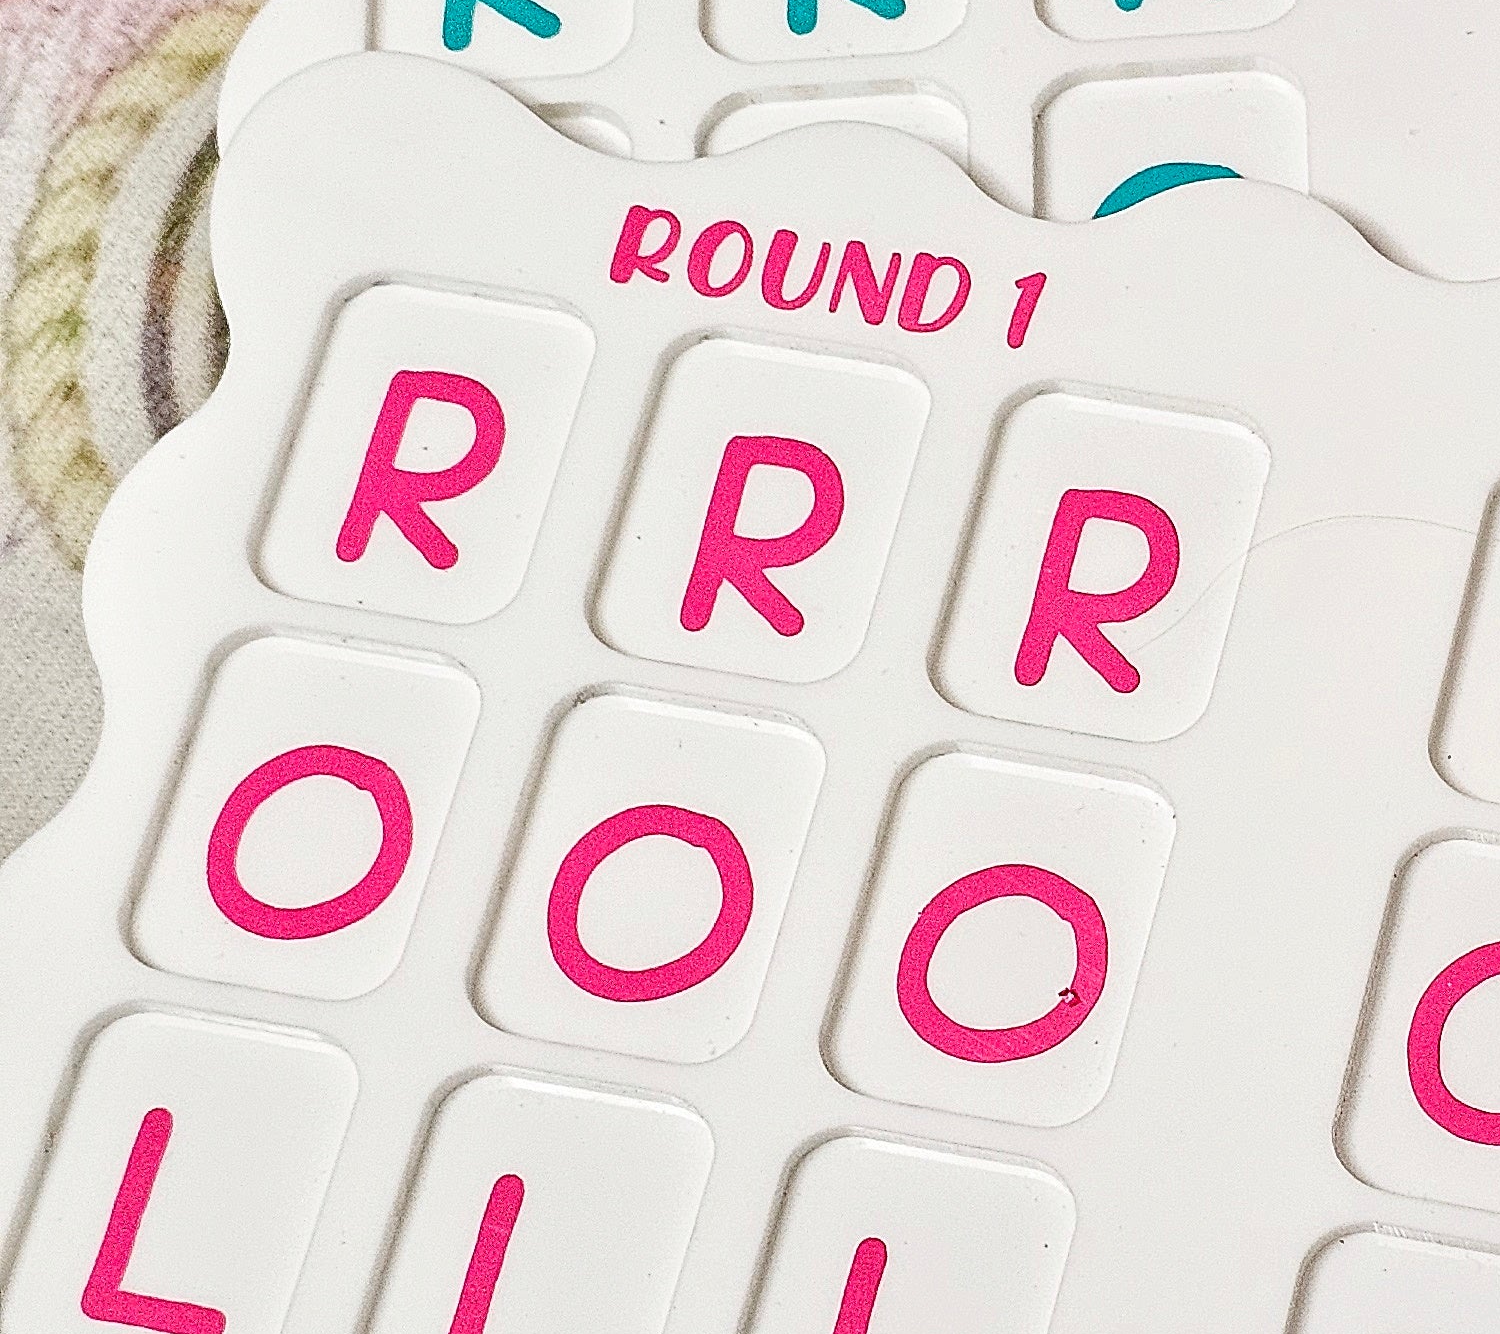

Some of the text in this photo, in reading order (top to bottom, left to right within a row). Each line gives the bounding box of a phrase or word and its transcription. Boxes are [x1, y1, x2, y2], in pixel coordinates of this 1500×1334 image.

[610, 205, 1046, 349] ROUND 1
[336, 370, 1180, 693] R R R
[206, 745, 1108, 1063] O O O
